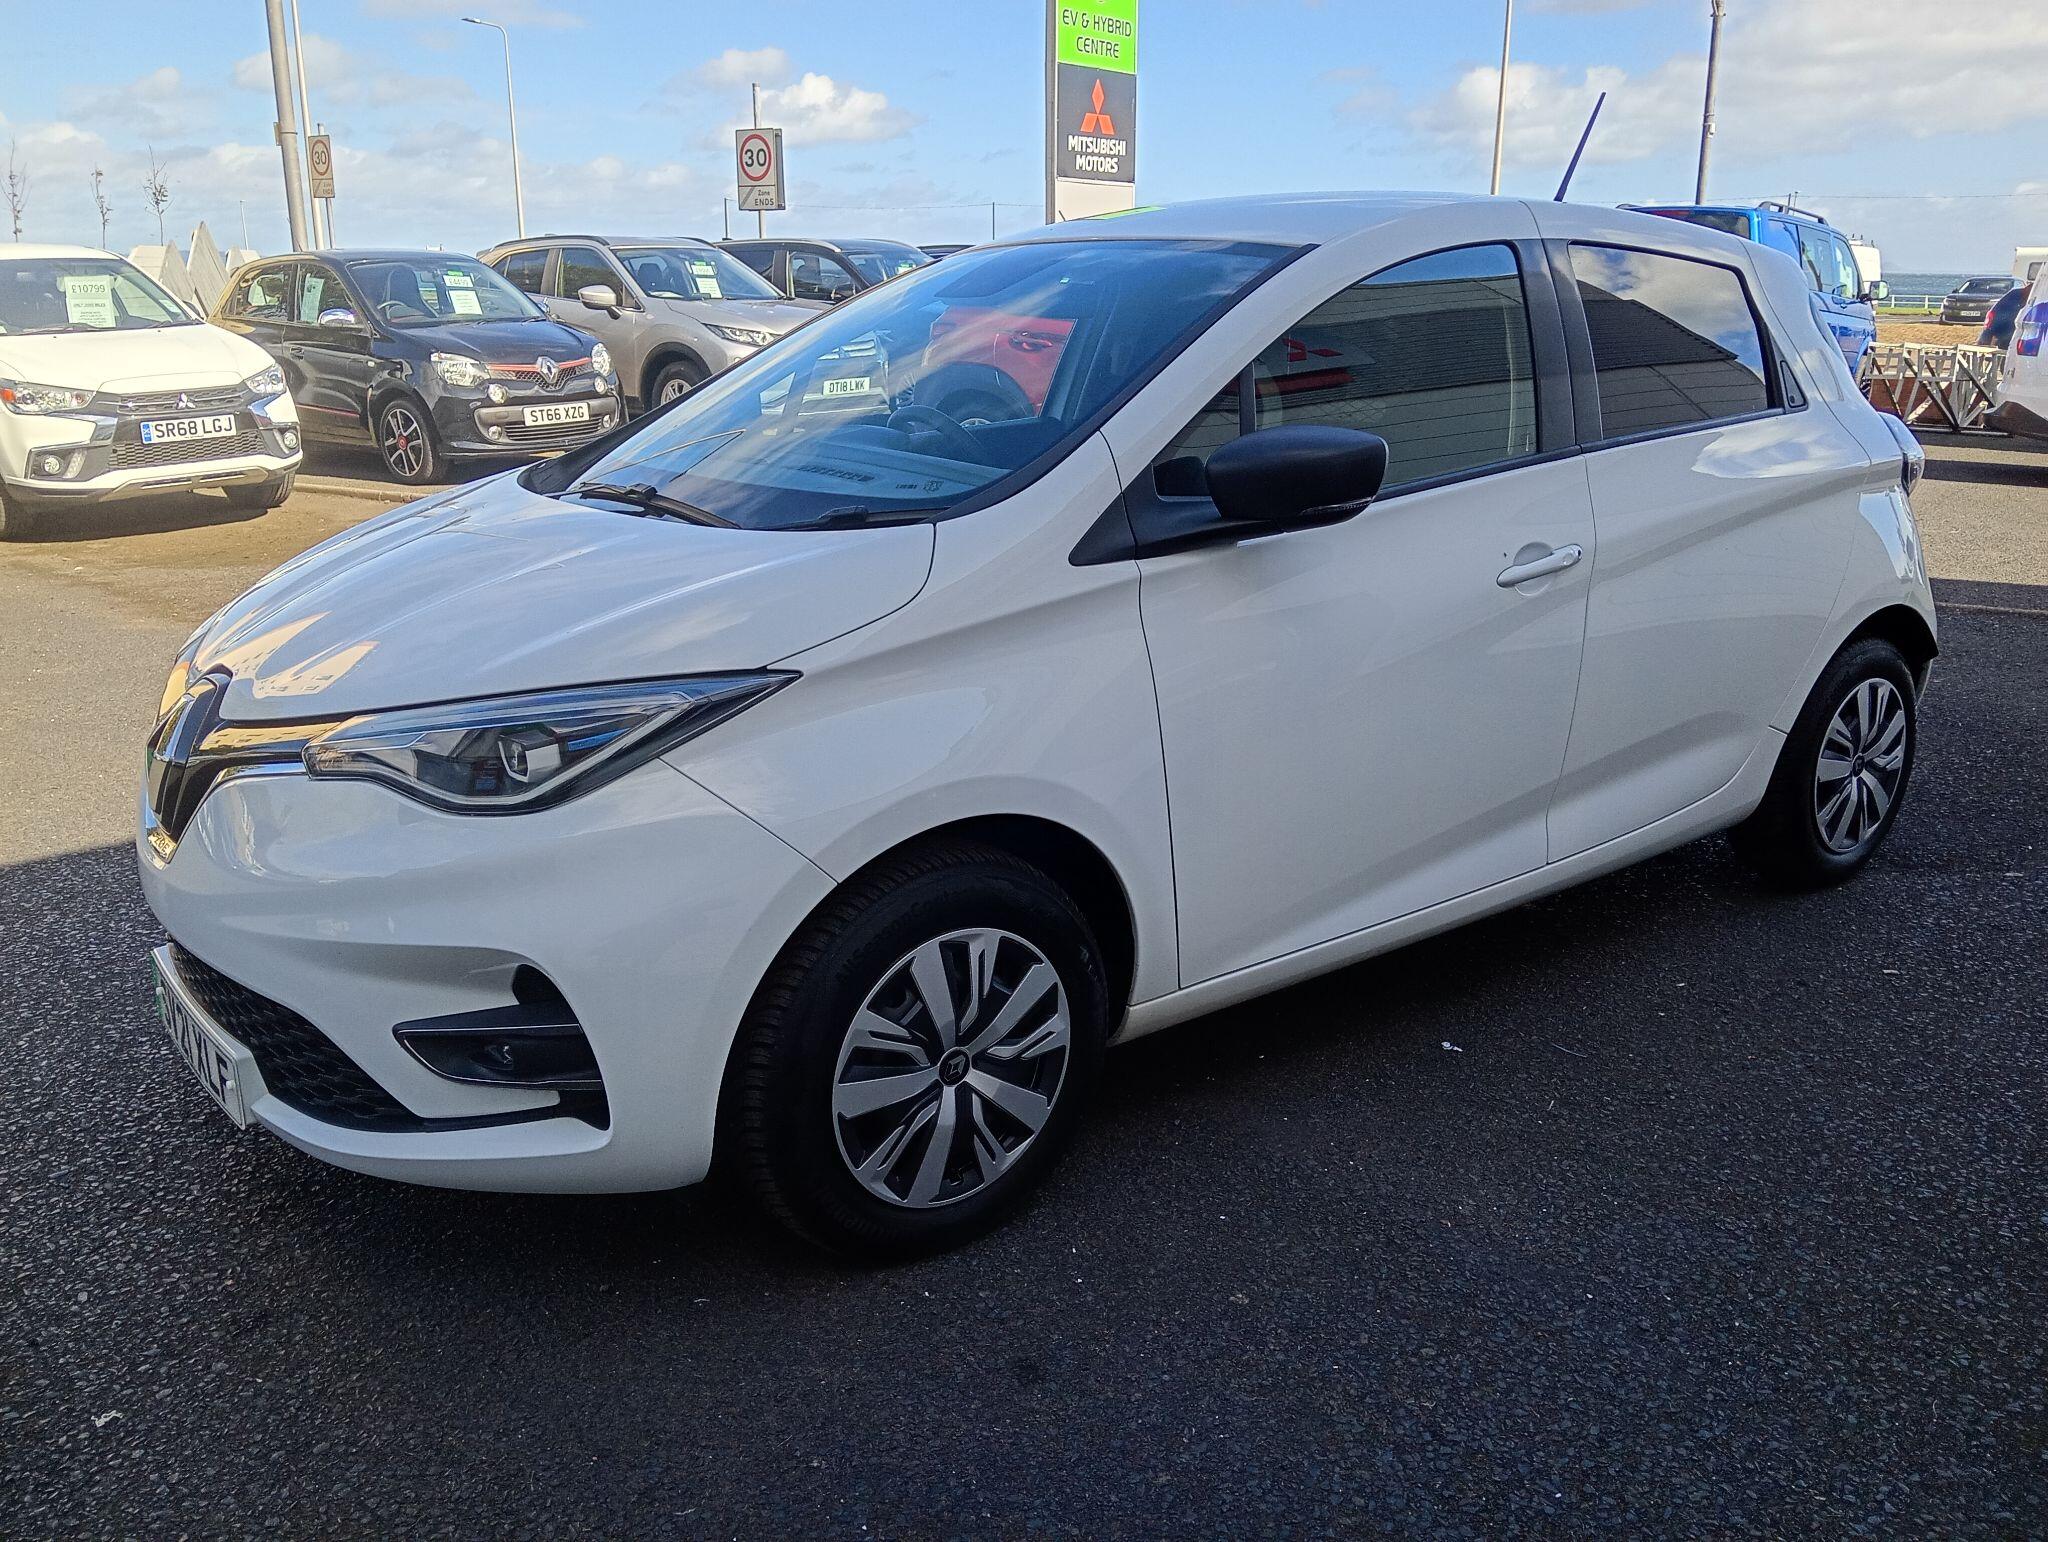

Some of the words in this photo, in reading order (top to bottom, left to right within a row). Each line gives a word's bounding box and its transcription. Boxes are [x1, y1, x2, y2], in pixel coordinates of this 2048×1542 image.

[1062, 9, 1079, 26] EV
[1081, 13, 1090, 29] &
[1093, 15, 1132, 37] HYBRID
[1076, 36, 1120, 59] CENTRE
[1067, 134, 1127, 156] MITSUBISHI
[314, 150, 327, 165] 30
[744, 148, 767, 168] 30
[1075, 154, 1119, 174] MOTORS
[754, 198, 775, 206] ENDS
[758, 189, 771, 197] Zone
[71, 284, 106, 293] £10799
[530, 408, 561, 423] ST66
[564, 406, 584, 420] XZG
[154, 420, 198, 439] SR68
[202, 416, 232, 434] LGJ
[191, 1023, 228, 1104] XLF
